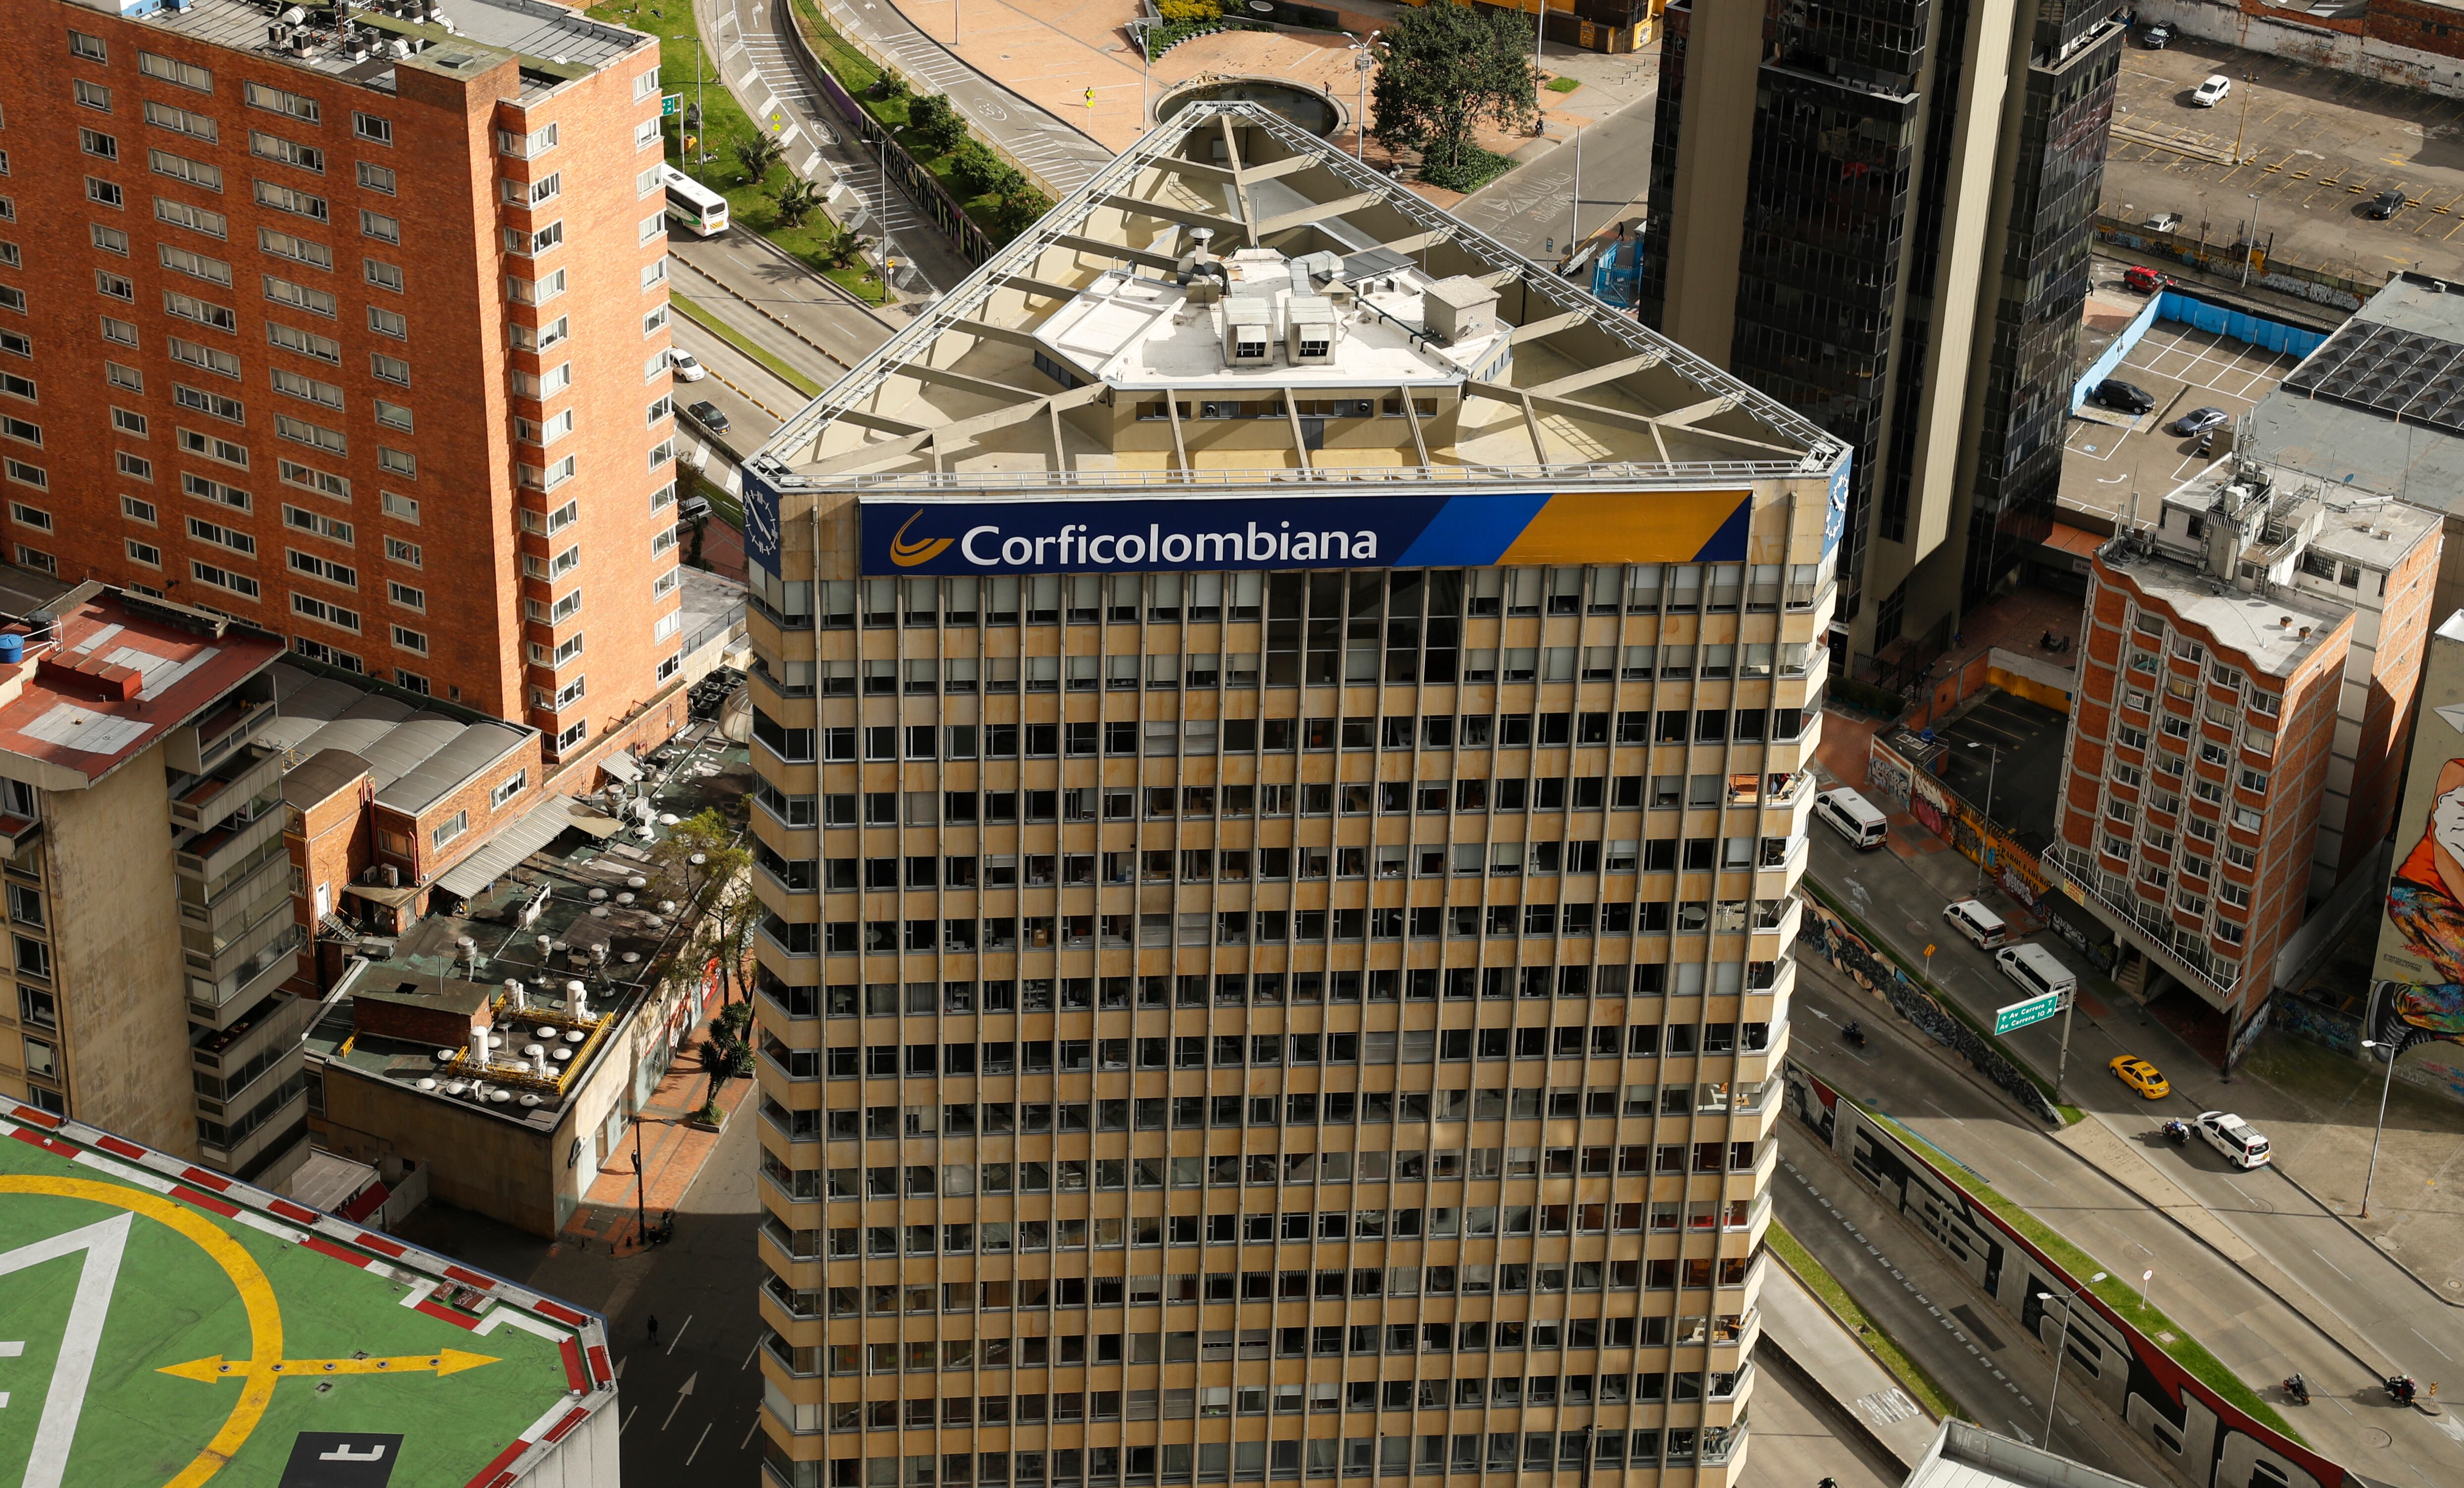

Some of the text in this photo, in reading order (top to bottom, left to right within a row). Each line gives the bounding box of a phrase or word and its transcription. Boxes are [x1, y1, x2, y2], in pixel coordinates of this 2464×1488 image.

[962, 522, 1376, 565] Corficolombiana
[2021, 1004, 2045, 1015] Carrera
[2011, 1015, 2035, 1026] Carrera
